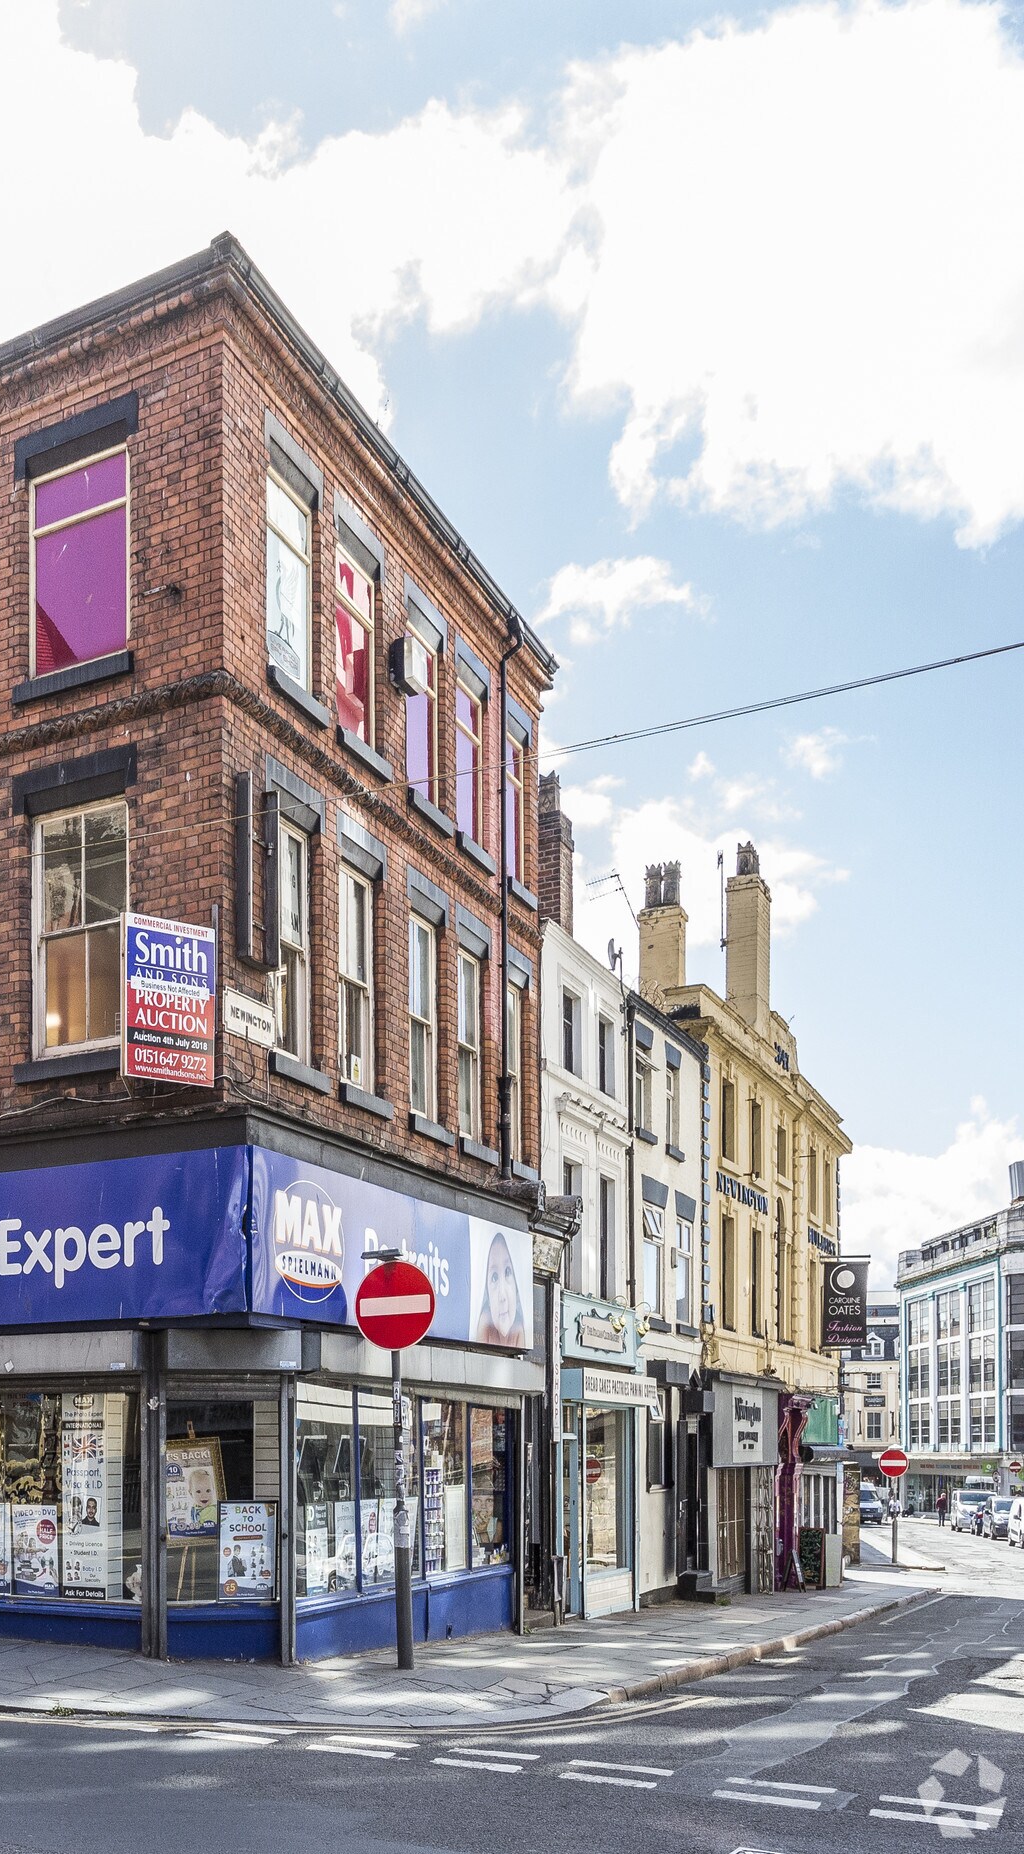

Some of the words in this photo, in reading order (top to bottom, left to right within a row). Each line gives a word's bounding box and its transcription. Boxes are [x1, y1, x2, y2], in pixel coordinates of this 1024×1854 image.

[133, 916, 172, 932] COMMERCIAL
[173, 925, 208, 938] INVESTMENT
[135, 931, 208, 974] Smith
[135, 967, 164, 981] AND
[171, 973, 207, 988] SONS
[141, 980, 167, 992] Business
[168, 985, 177, 993] Not
[178, 986, 200, 997] Affected
[135, 990, 207, 1015] PROPERTY
[134, 1008, 208, 1035] AUCTION
[230, 1005, 272, 1034] NEWINGTON
[133, 1032, 162, 1045] Auction
[163, 1036, 174, 1046] 4th
[175, 1038, 190, 1050] July
[191, 1040, 208, 1051] 2018
[181, 1053, 207, 1072] 9272
[716, 1171, 768, 1216] NEWINGTON
[275, 1189, 343, 1257] MAX
[282, 1255, 337, 1281] SPIELMANN
[364, 1227, 450, 1297] Ptraits
[828, 1306, 861, 1316] OATES
[826, 1321, 862, 1332] Fashion
[826, 1333, 864, 1343] Designer
[585, 1376, 598, 1392] BREAD
[599, 1378, 611, 1394] CAKES
[612, 1380, 629, 1396] PASTRIES
[630, 1381, 643, 1398] PANINI
[181, 1451, 211, 1460] BACK!
[66, 1467, 101, 1478] Passport,
[235, 1506, 261, 1514] BACK
[229, 1524, 267, 1532] SCHOOL
[85, 1590, 104, 1598] Details
